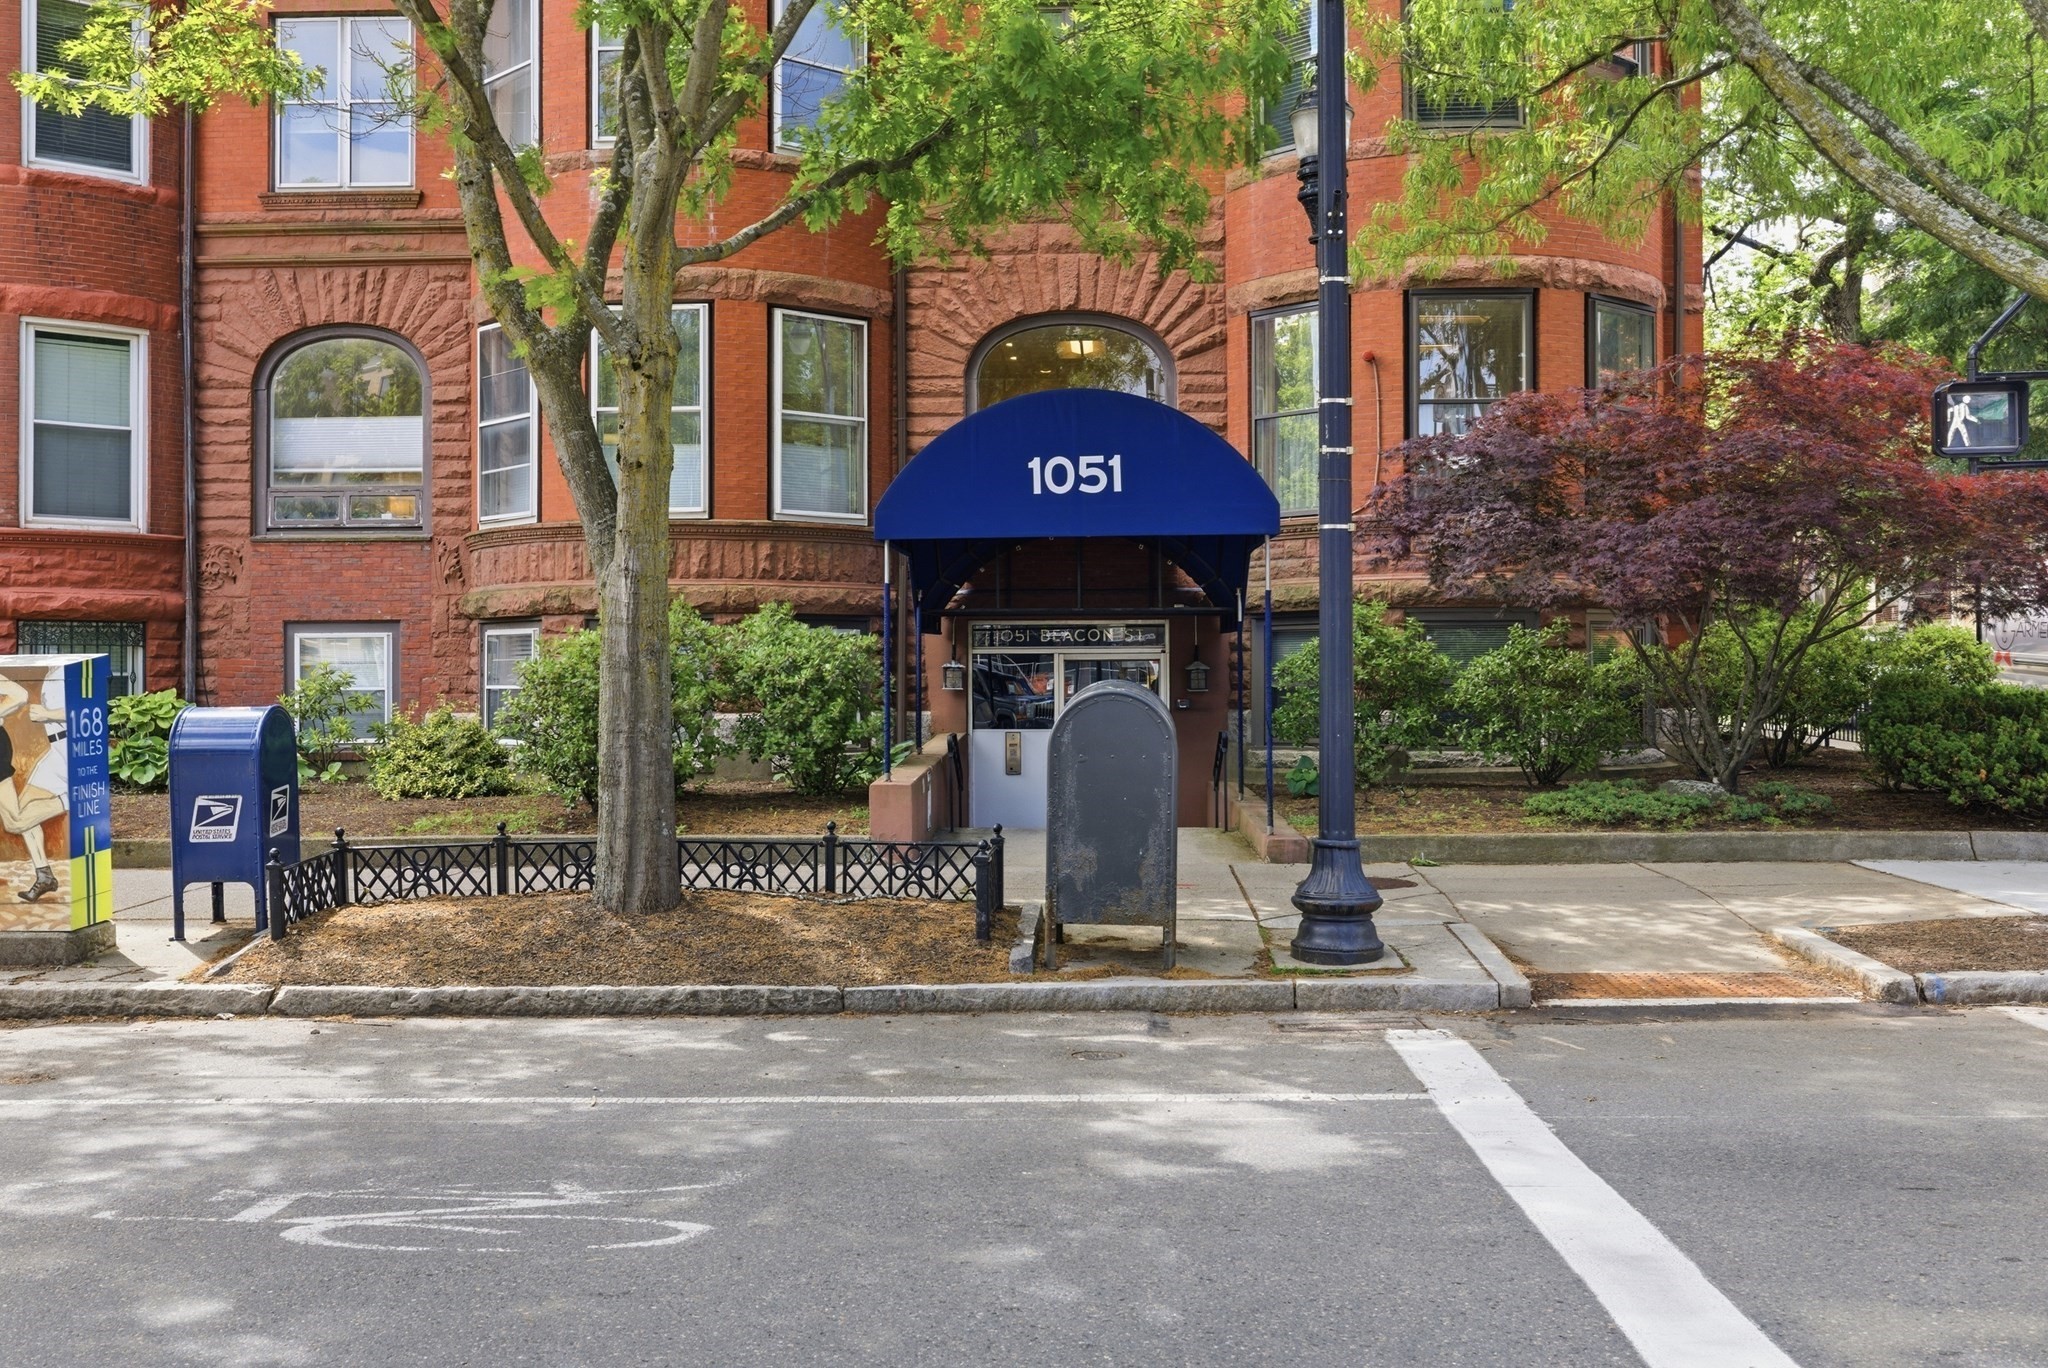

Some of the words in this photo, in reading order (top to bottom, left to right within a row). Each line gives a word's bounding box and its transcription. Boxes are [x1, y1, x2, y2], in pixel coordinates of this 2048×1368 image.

[1028, 454, 1122, 494] 1051
[1040, 629, 1113, 642] BEACON
[1125, 629, 1144, 642] ST
[70, 707, 103, 738] 1.68
[72, 739, 103, 757] MILES
[77, 767, 86, 777] TO
[86, 765, 98, 775] THE
[73, 781, 105, 801] FINISH
[79, 800, 100, 818] LINE
